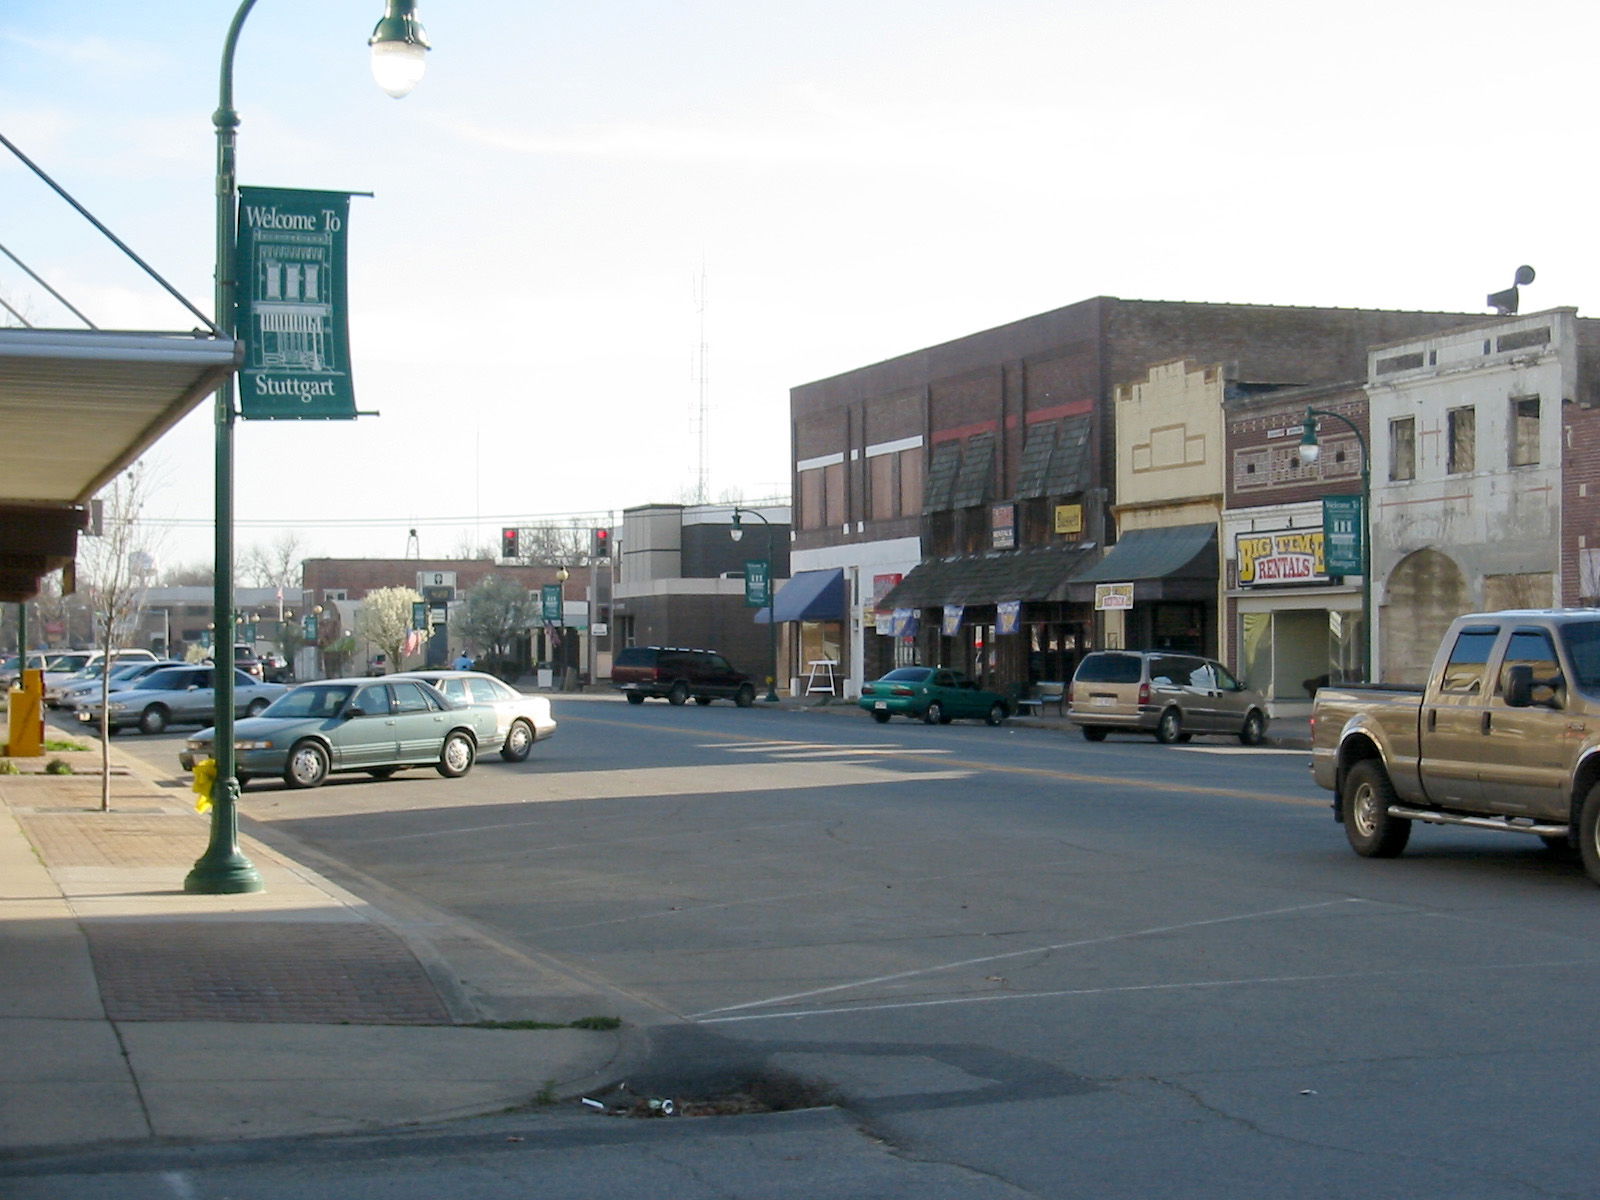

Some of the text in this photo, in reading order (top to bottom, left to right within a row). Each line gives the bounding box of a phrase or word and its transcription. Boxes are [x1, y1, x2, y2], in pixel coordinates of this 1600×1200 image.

[246, 205, 341, 232] Welcome To
[256, 374, 336, 403] Stuttgart
[1238, 537, 1272, 583] BIG
[1258, 556, 1311, 579] RENTALS
